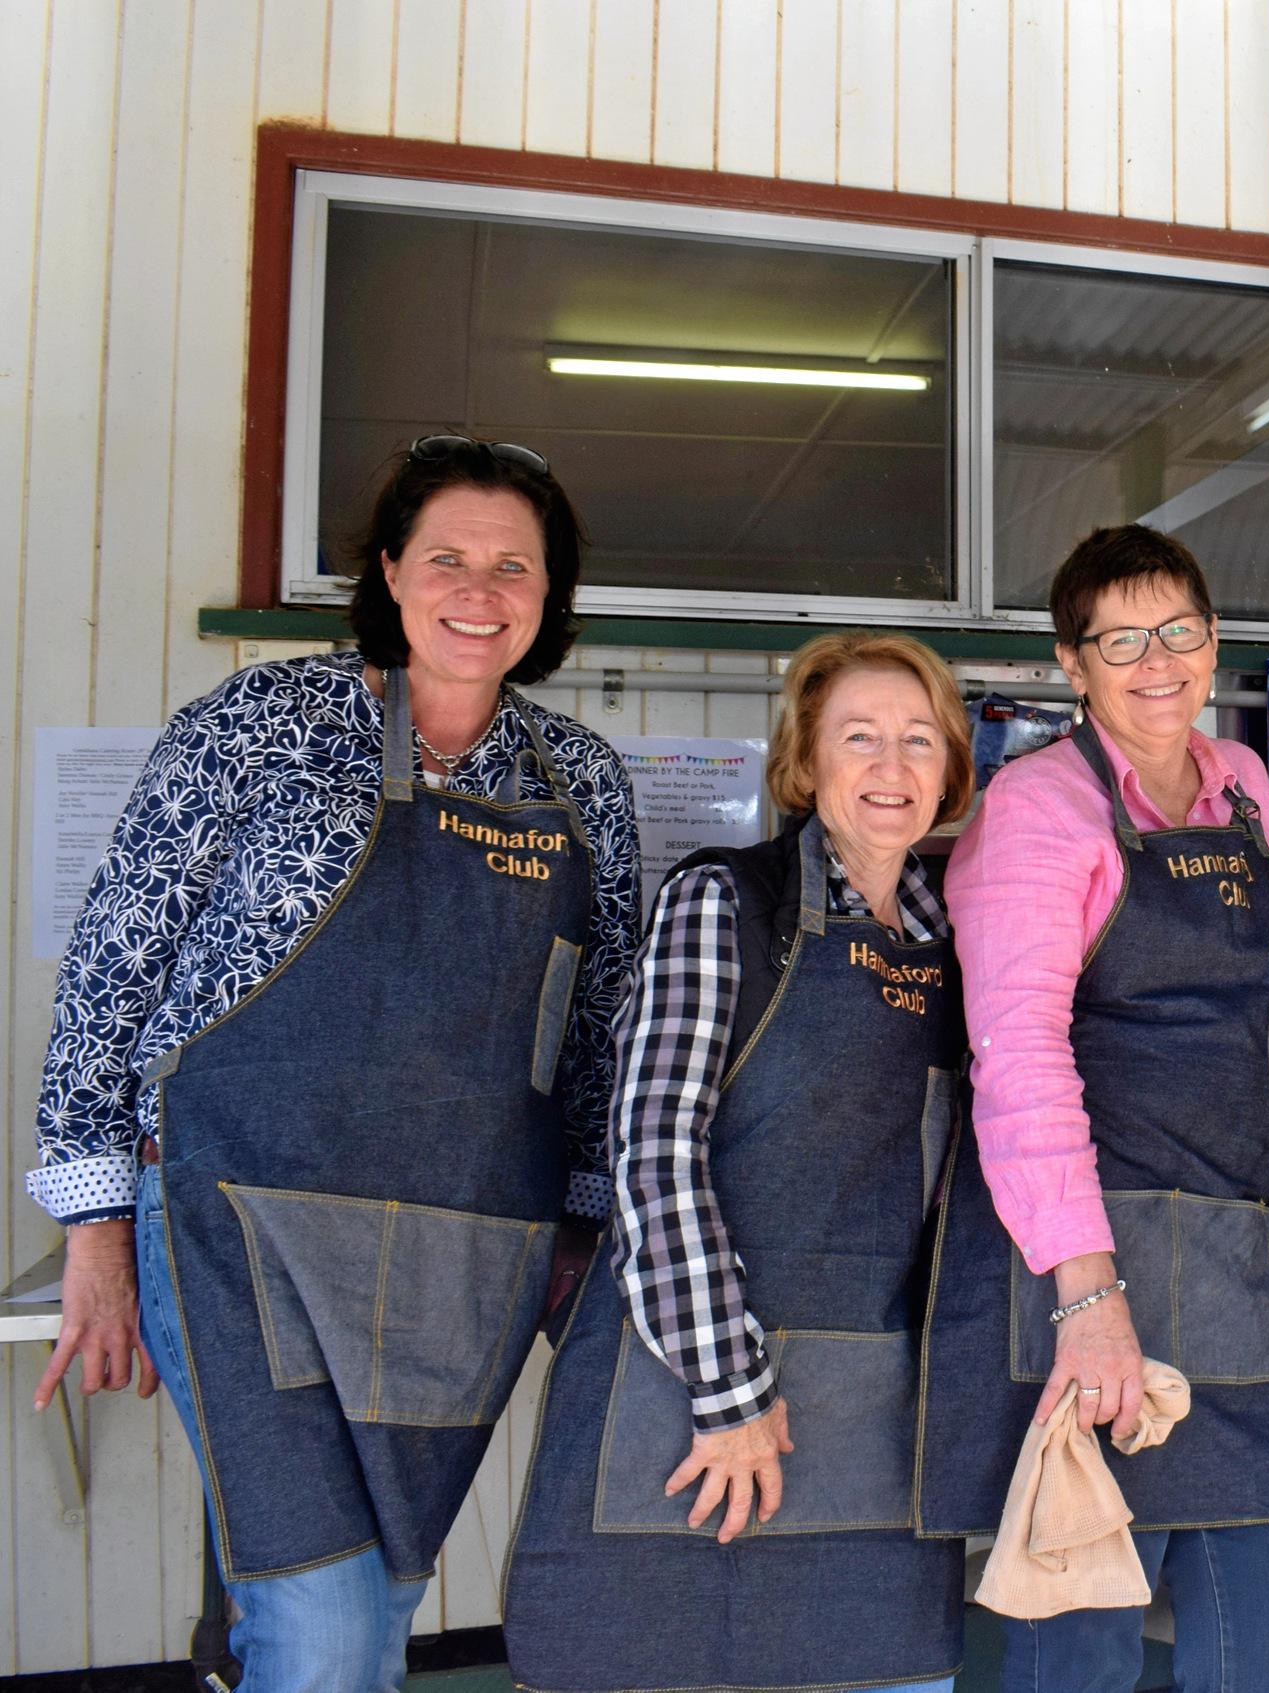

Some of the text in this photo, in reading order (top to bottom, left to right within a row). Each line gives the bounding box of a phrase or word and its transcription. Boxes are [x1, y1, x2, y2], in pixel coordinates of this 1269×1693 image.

[675, 767, 690, 776] THE
[693, 768, 719, 777] CAMP
[722, 768, 740, 778] FIRE
[486, 851, 550, 880] Club
[1219, 880, 1251, 909] Clu
[882, 985, 926, 1015] Club
